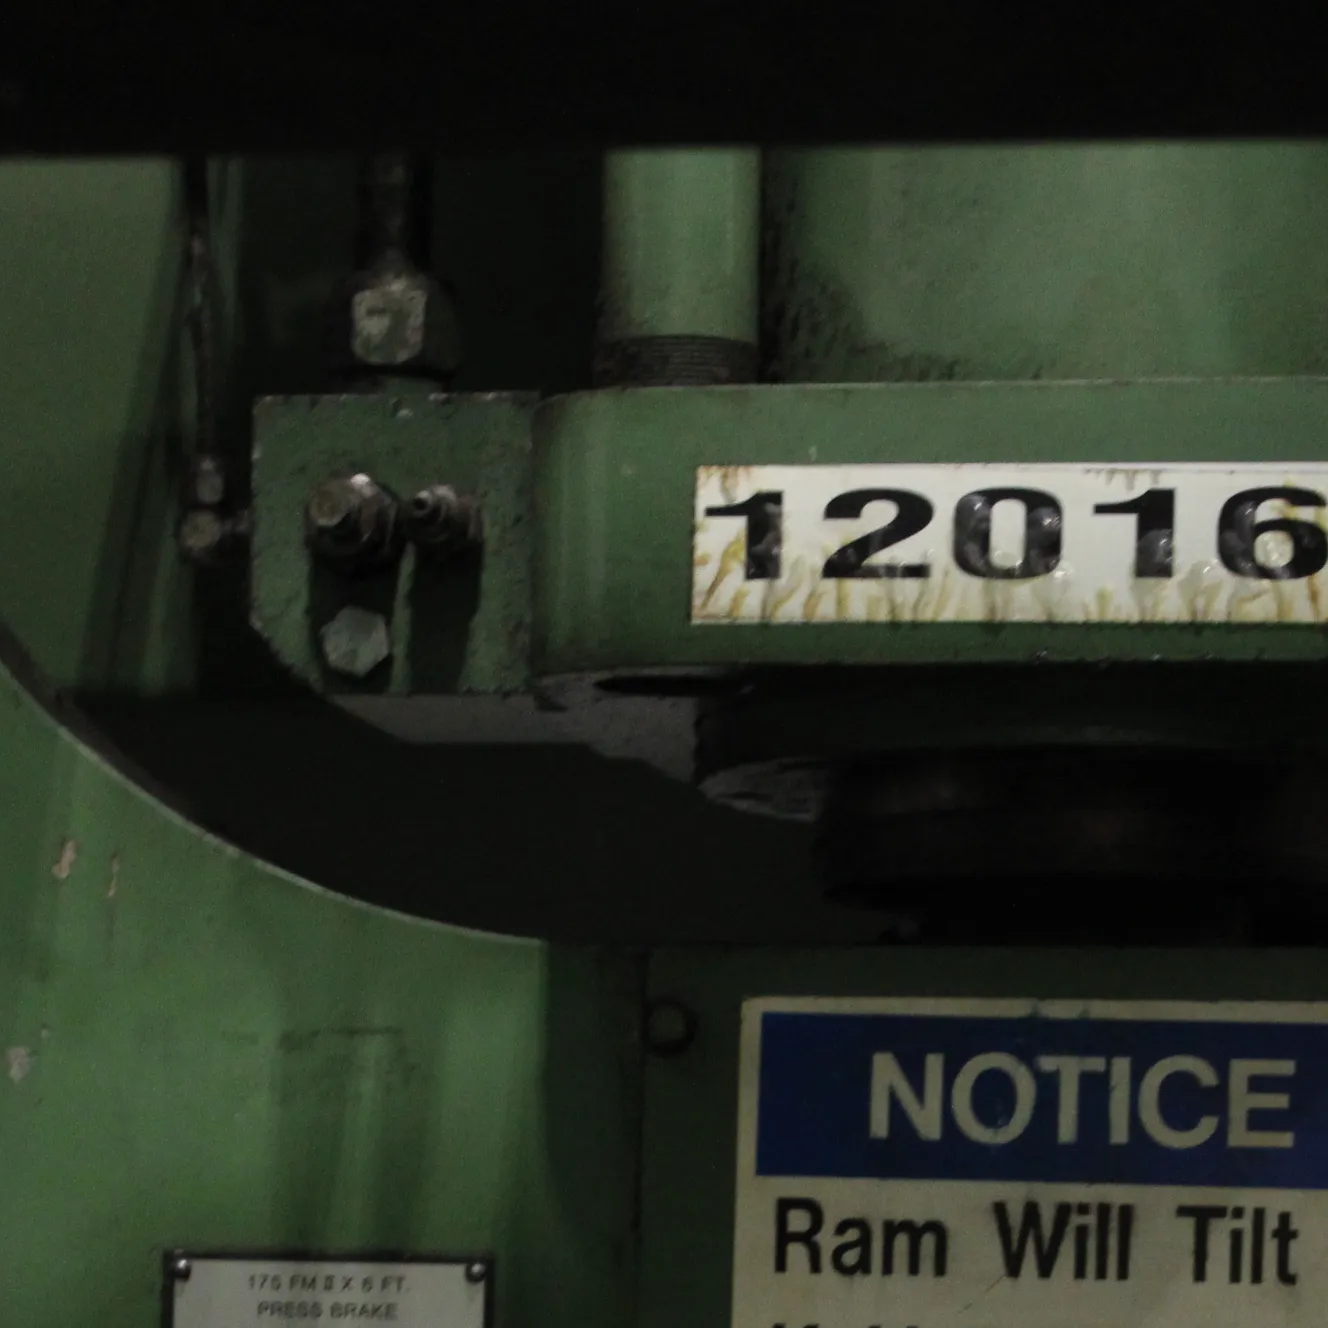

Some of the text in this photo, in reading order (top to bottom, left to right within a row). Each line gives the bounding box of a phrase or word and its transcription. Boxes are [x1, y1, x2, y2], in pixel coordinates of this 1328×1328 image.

[869, 1051, 1297, 1150] NOTICE
[773, 1197, 1299, 1286] Ram Will Tilt
[257, 1300, 399, 1321] PRESS BRAKE
[289, 1274, 316, 1292] FM
